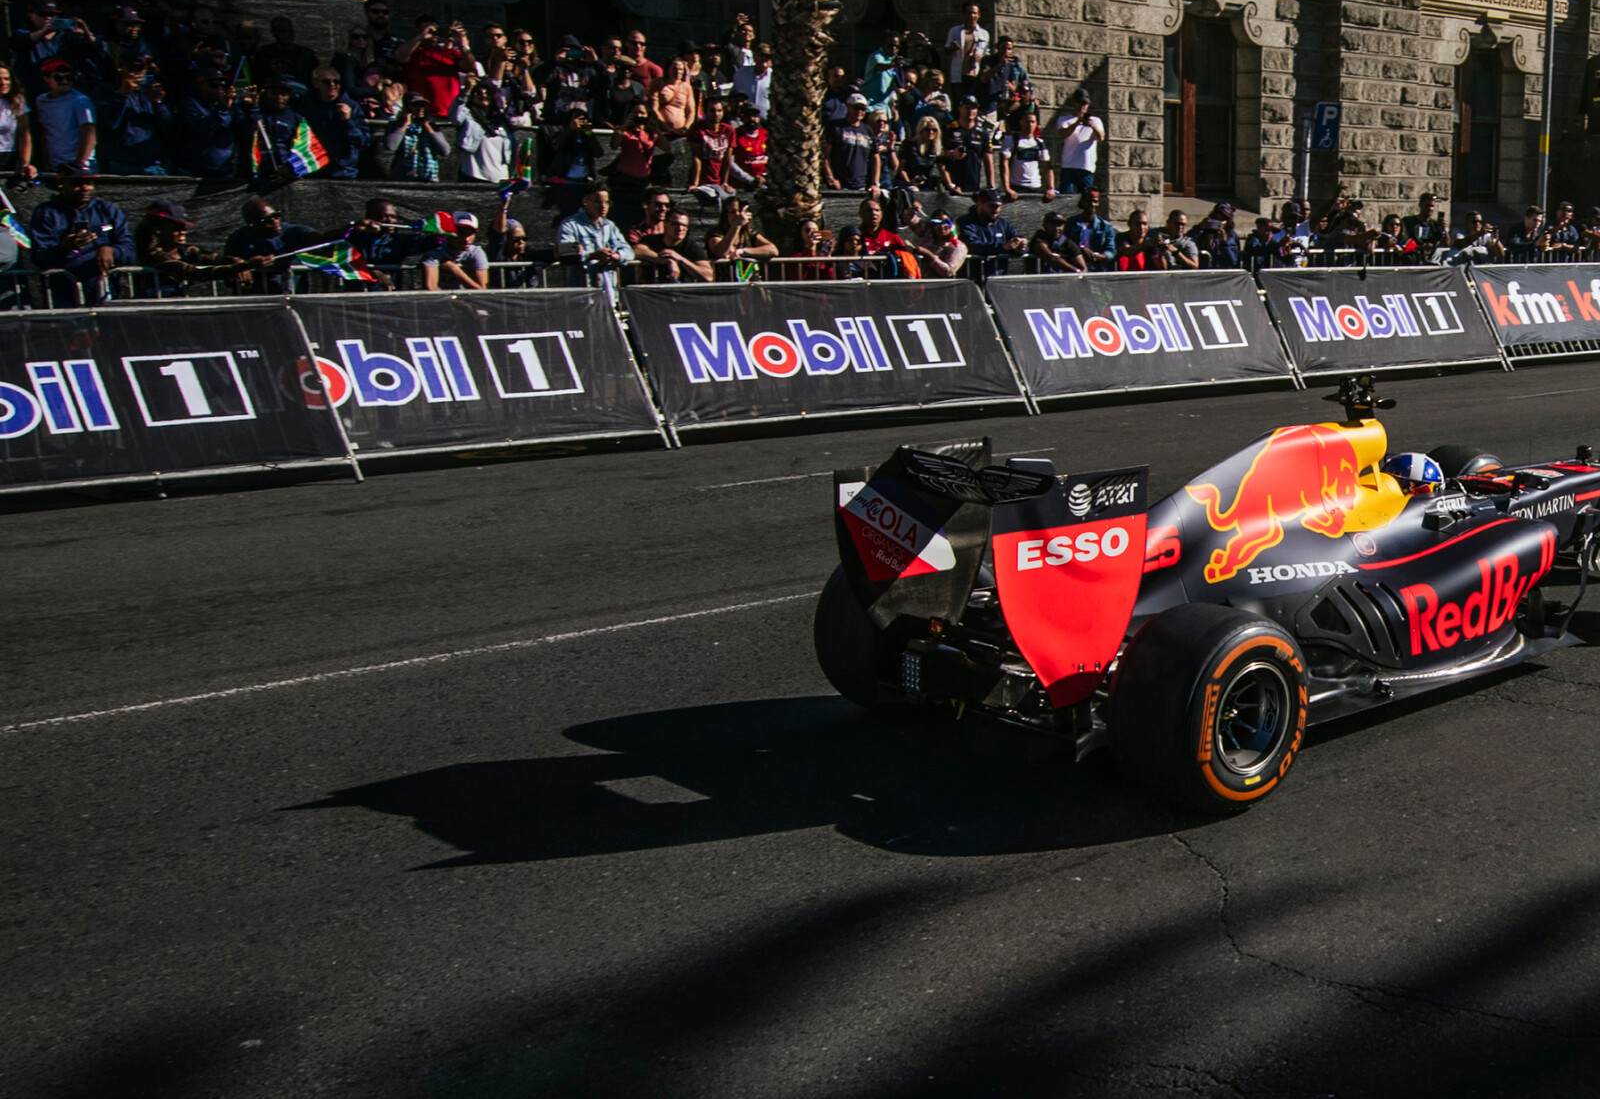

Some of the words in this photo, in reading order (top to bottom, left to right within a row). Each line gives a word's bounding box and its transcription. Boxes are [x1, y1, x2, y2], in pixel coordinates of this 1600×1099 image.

[1322, 106, 1338, 125] P
[1288, 294, 1421, 342] Mobil
[1482, 279, 1567, 326] kfm
[669, 315, 892, 383] Mobil
[1024, 302, 1193, 360] Mobil
[1536, 493, 1576, 519] MARTIN
[1017, 527, 1129, 571] ESSO
[1248, 561, 1358, 584] HONDA
